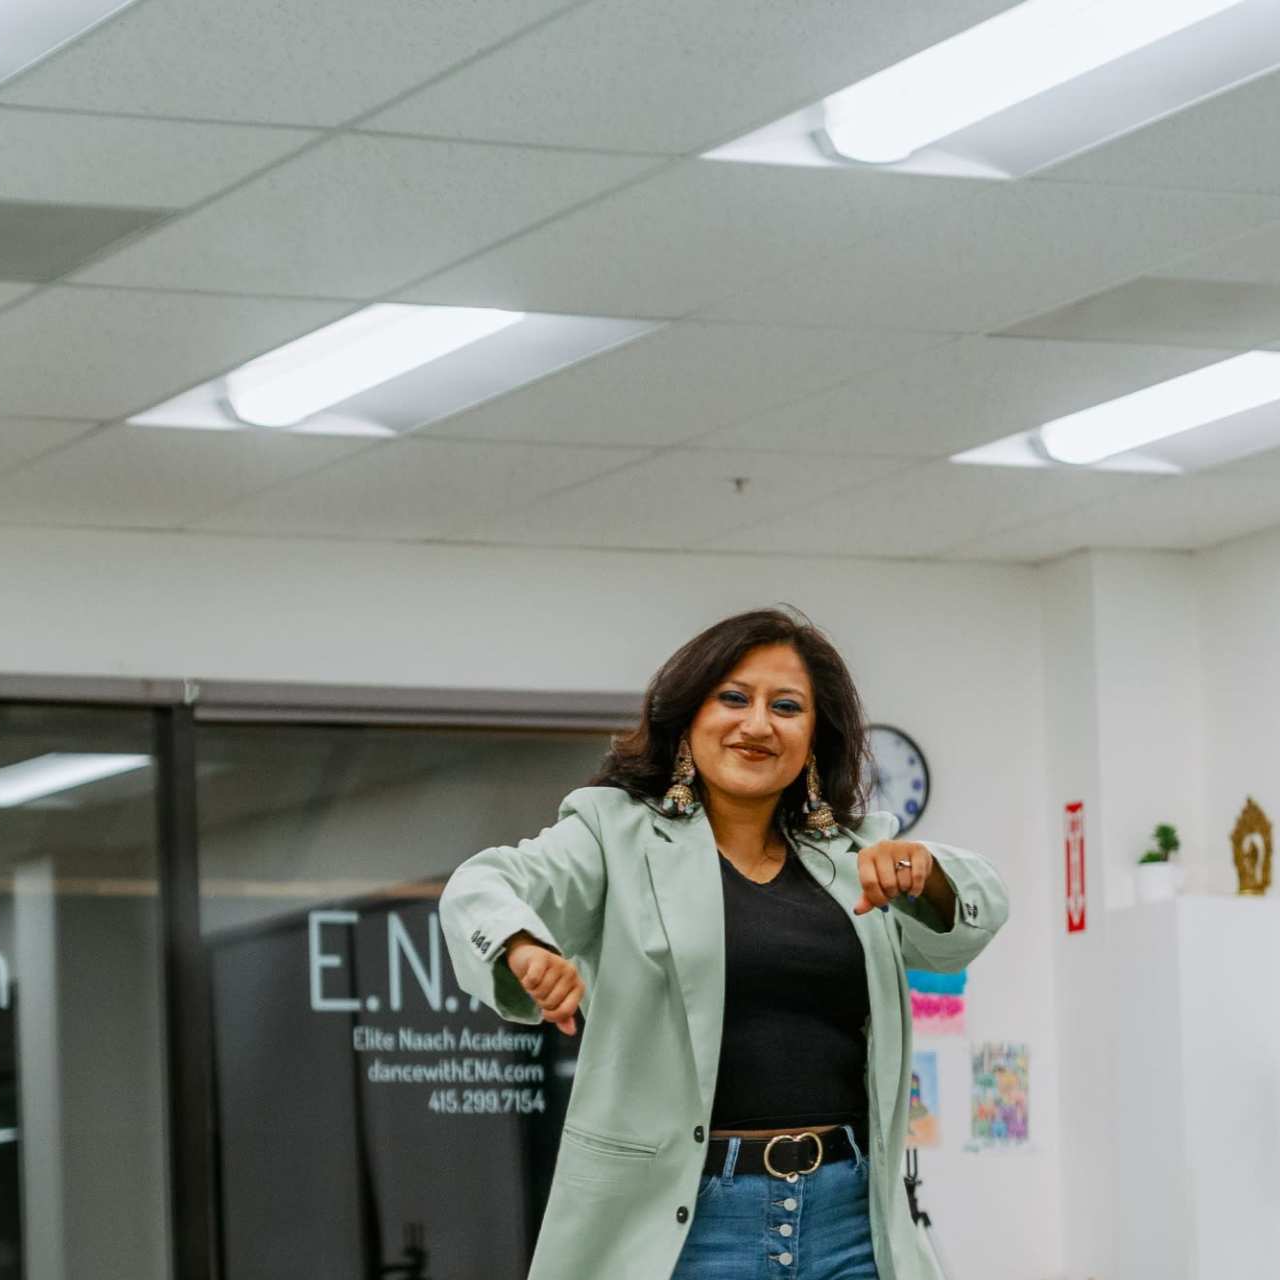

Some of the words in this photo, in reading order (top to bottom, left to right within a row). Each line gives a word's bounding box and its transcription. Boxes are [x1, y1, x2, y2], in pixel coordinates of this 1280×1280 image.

[308, 910, 484, 1013] E.N.
[352, 1026, 394, 1051] Elite
[399, 1027, 454, 1051] Naach
[459, 1026, 544, 1057] Academy
[368, 1059, 544, 1083] dancewithENA.com
[428, 1088, 546, 1114] 415.299.7154
